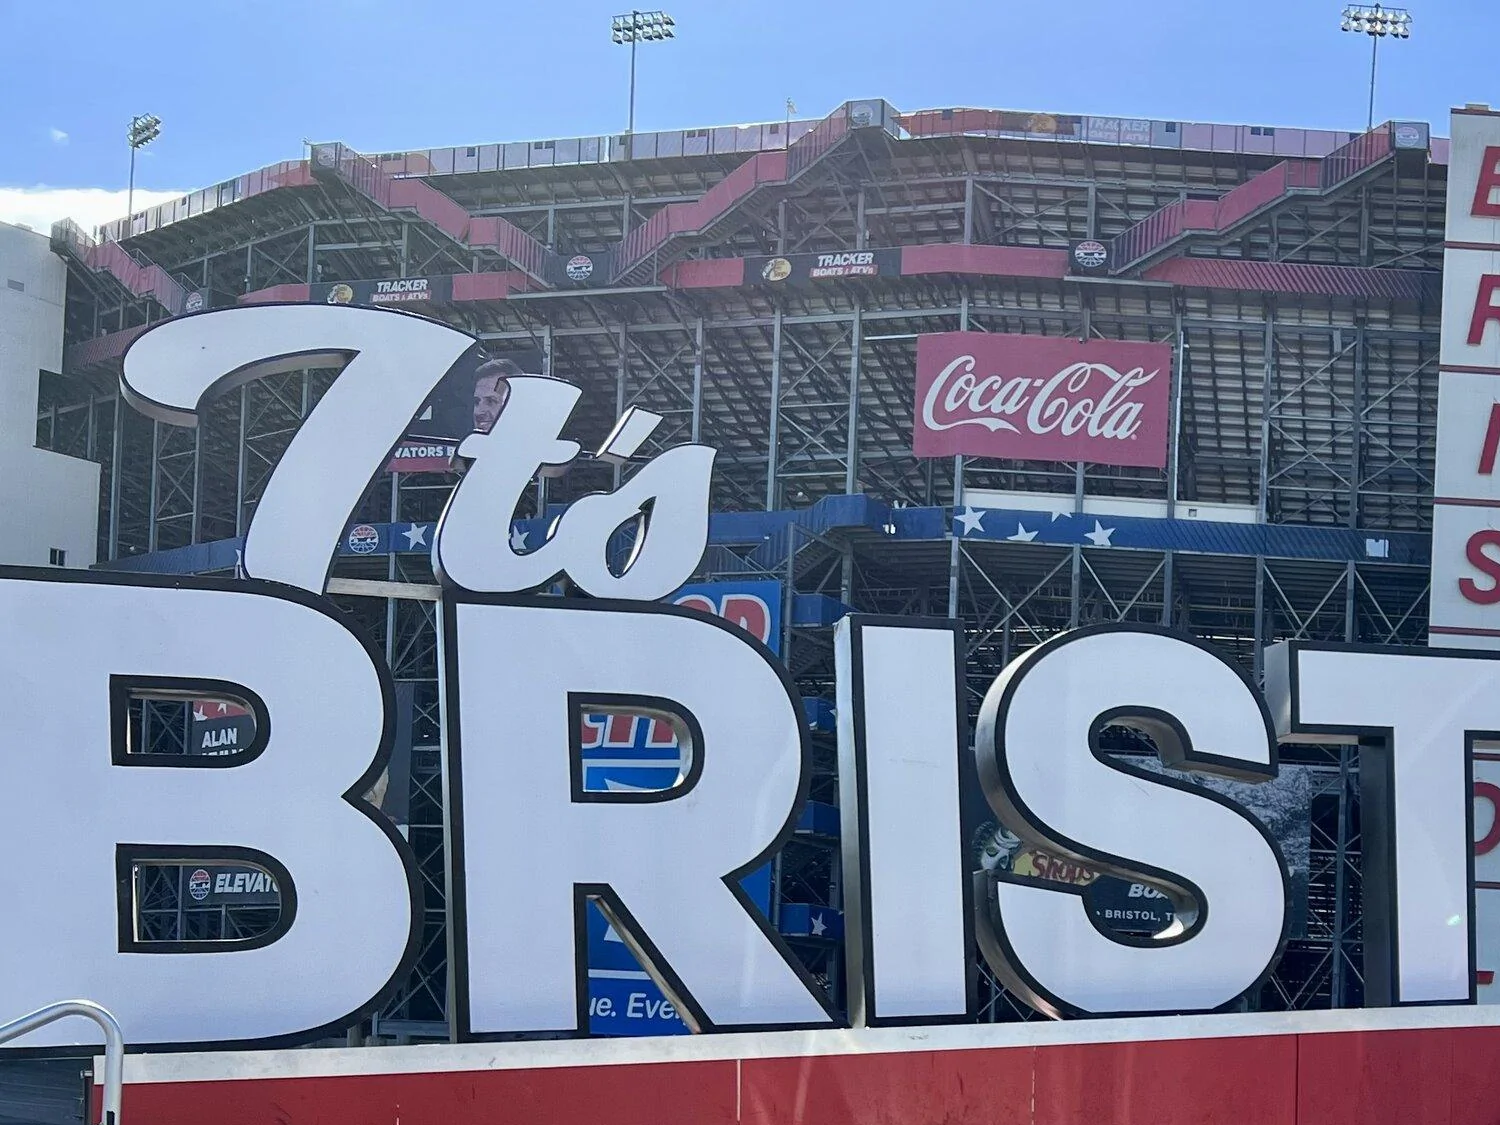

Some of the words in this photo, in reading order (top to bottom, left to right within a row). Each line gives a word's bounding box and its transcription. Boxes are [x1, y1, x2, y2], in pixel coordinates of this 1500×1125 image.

[817, 252, 874, 267] TRACKER
[812, 267, 843, 277] BOATS
[376, 278, 429, 293] TRACKER
[372, 293, 400, 302] BOATS
[923, 355, 1160, 440] Coca-Cola
[201, 727, 238, 749] ALAN
[1105, 909, 1161, 922] BRISTOL,
